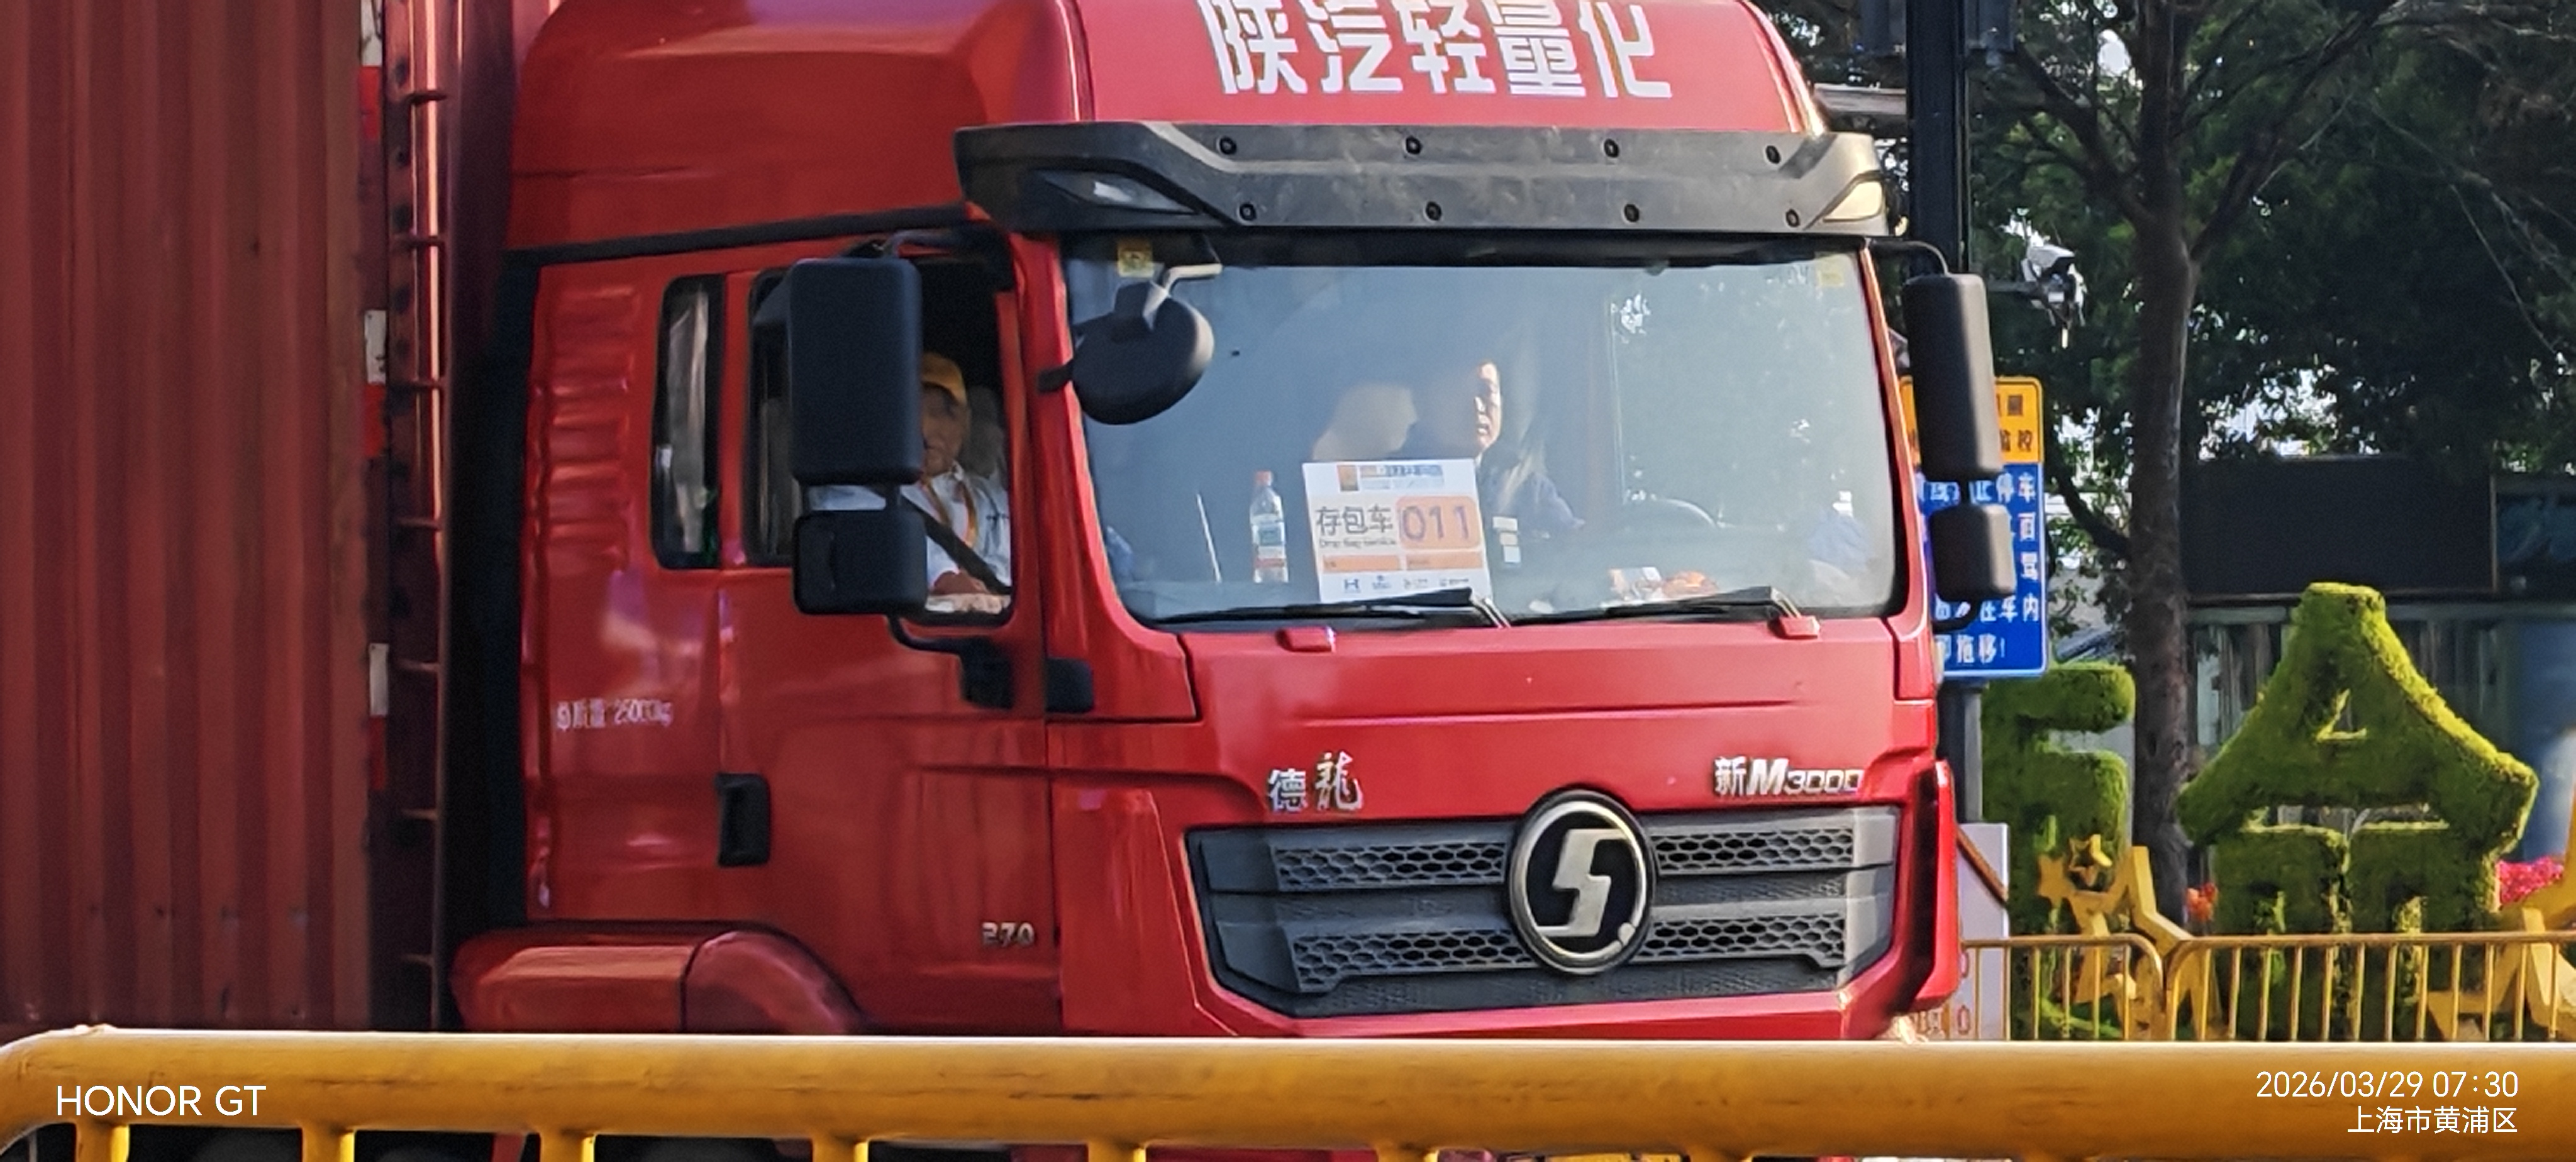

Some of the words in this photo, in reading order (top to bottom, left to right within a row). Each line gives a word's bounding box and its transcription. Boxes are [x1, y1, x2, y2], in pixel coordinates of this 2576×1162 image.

[1197, 0, 1672, 98] 陕汽轻量化
[1316, 504, 1394, 536] 存包车
[1402, 506, 1470, 541] 011
